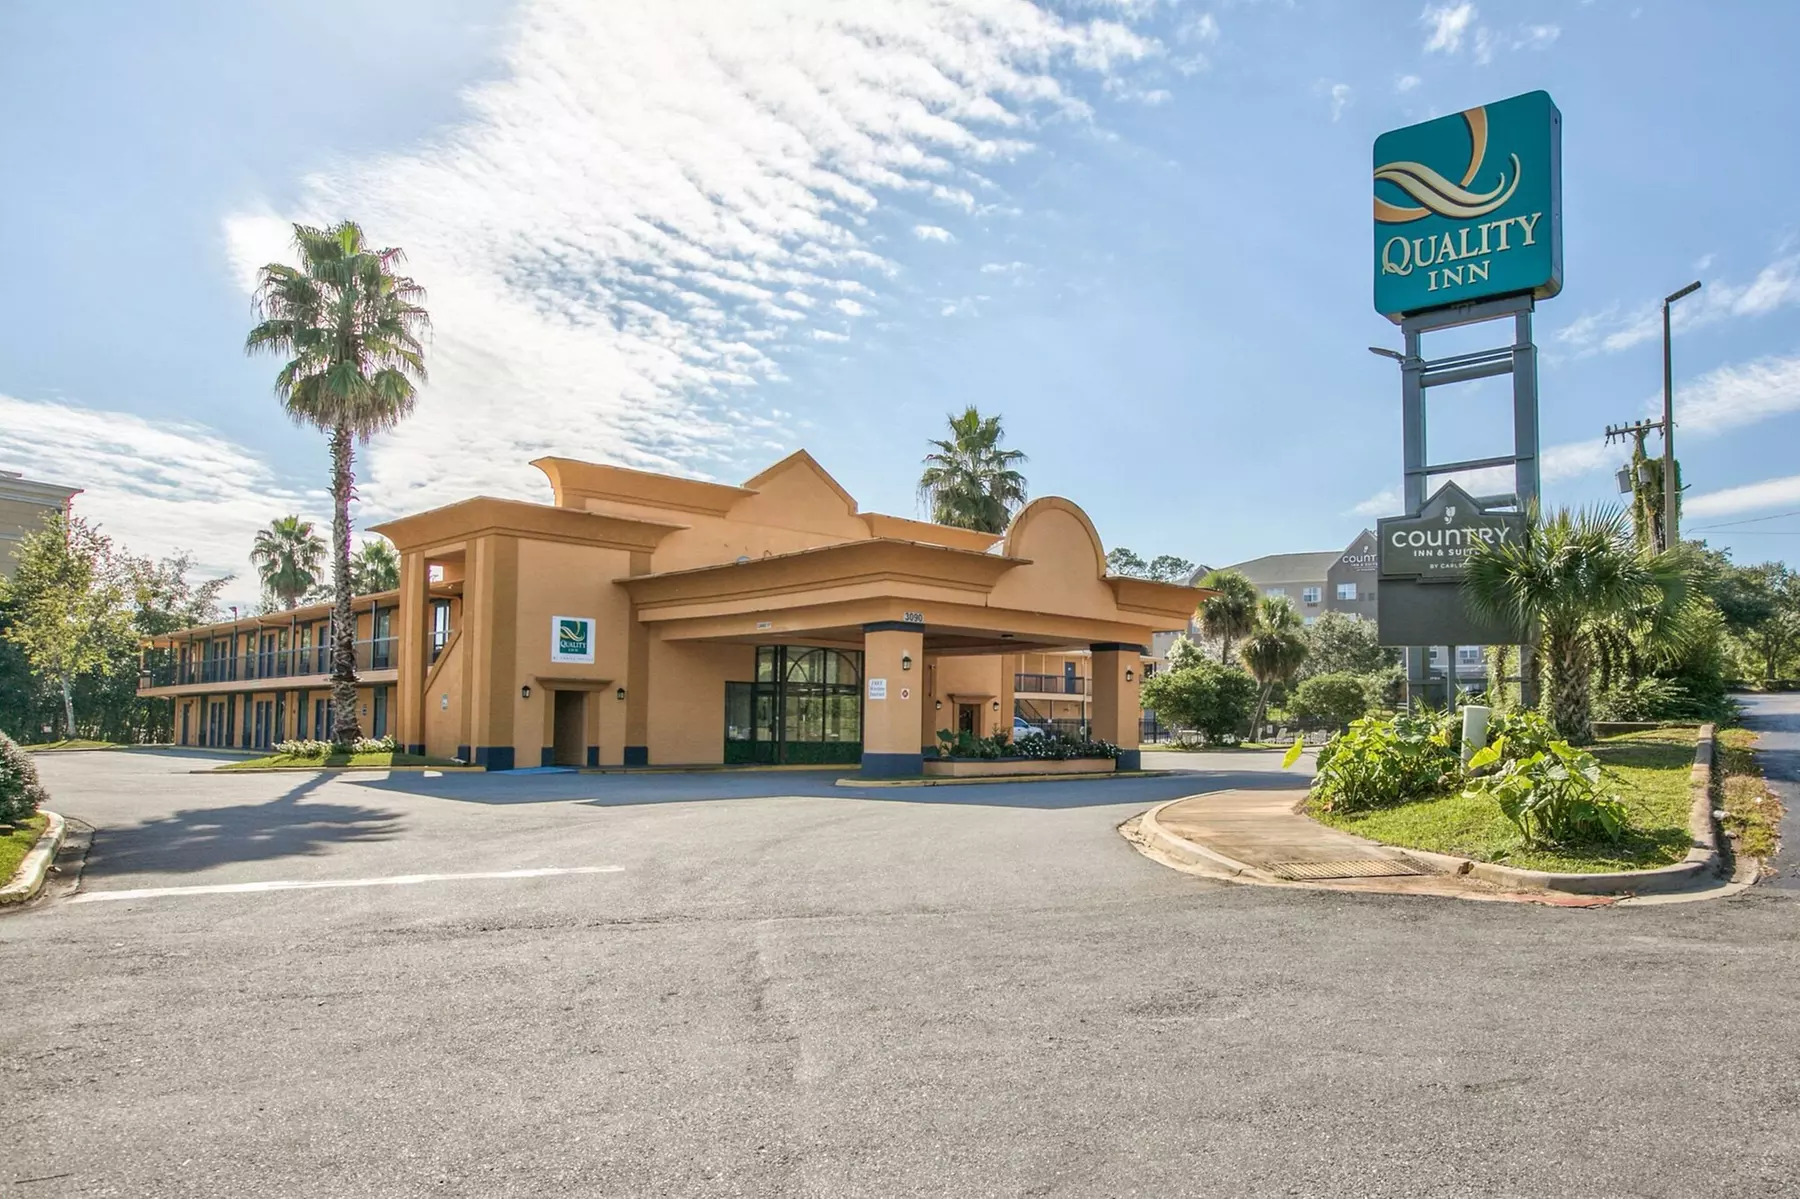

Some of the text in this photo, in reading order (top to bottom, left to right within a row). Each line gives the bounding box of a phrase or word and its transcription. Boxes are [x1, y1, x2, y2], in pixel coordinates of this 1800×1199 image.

[1382, 212, 1542, 276] QUALITY
[1427, 260, 1490, 292] INN
[1413, 549, 1433, 557] INN
[1437, 549, 1444, 557] &
[1342, 554, 1377, 564] COUNT
[904, 612, 923, 622] 3090
[560, 640, 586, 649] QUALITY
